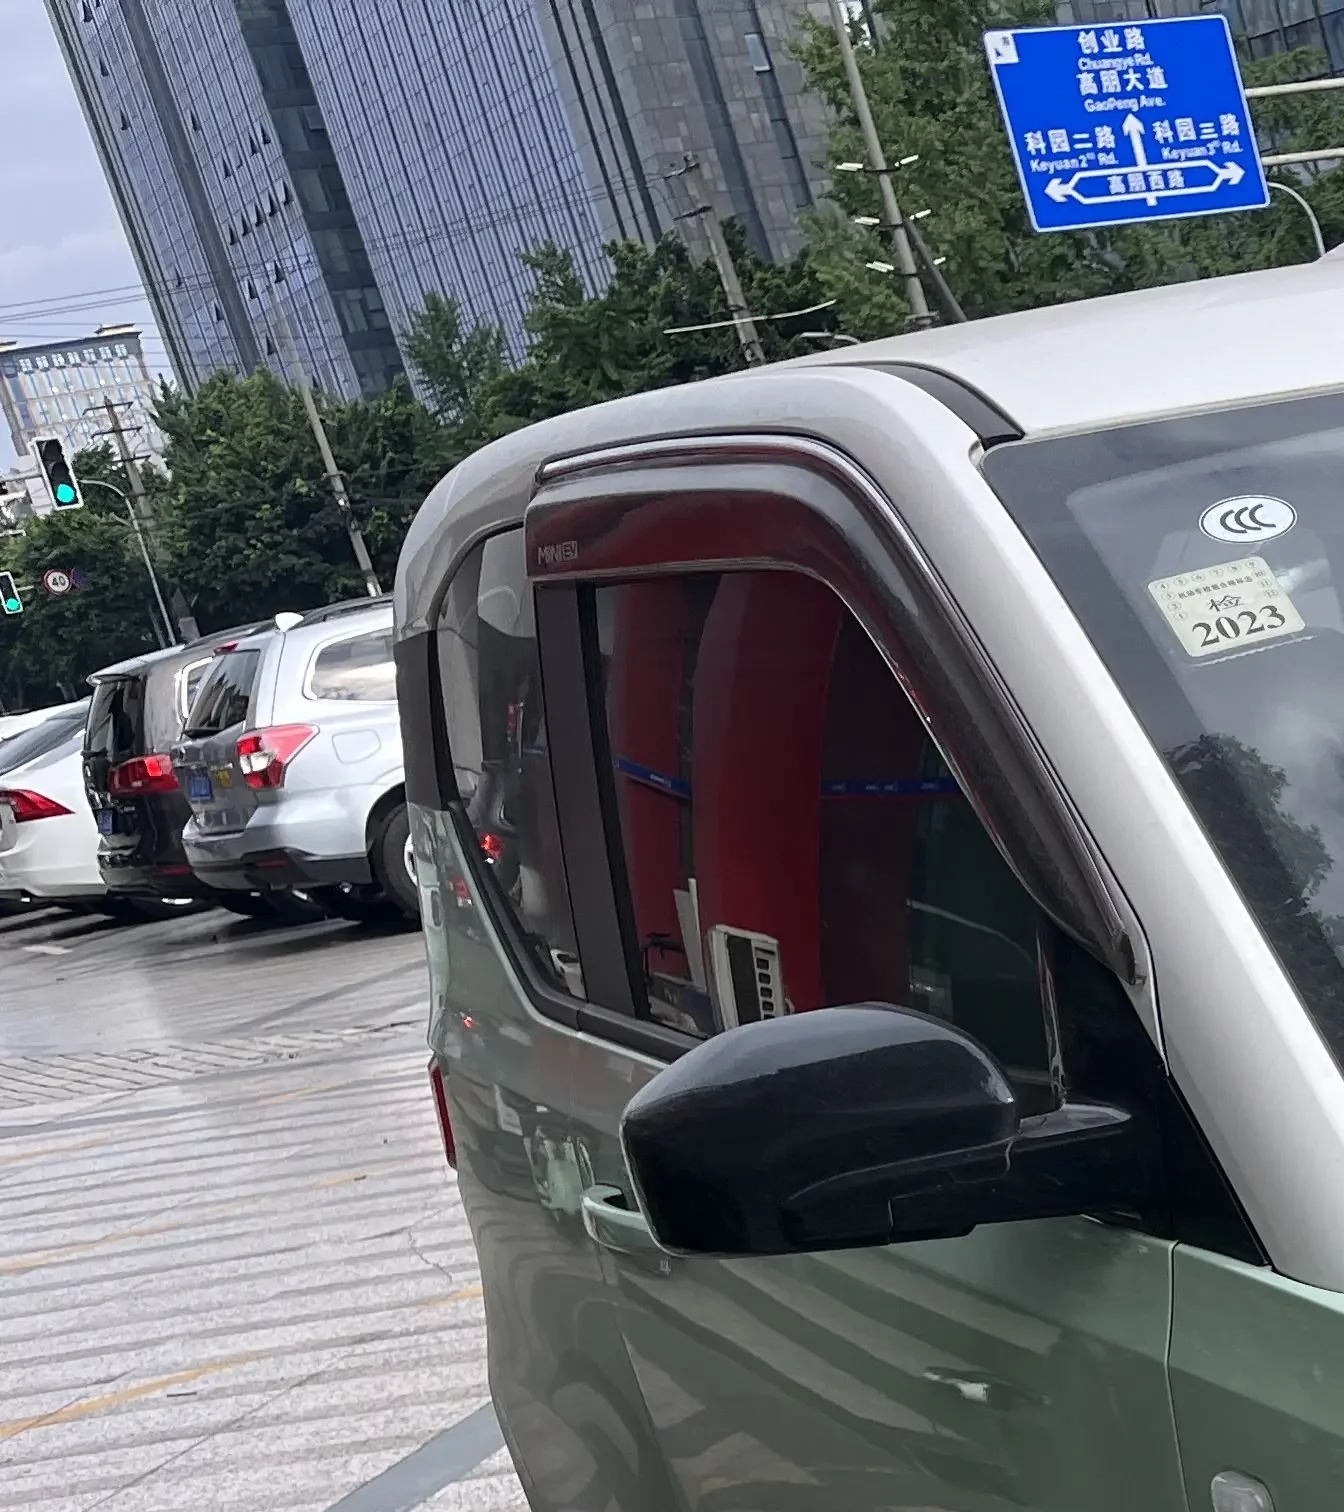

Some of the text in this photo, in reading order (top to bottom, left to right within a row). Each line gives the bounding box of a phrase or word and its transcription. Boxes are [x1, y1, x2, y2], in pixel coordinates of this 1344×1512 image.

[1078, 27, 1145, 54] 创业路
[1076, 66, 1168, 96] 高朋大道
[1140, 95, 1166, 108] Ave.
[1024, 125, 1116, 155] 科园二路
[1152, 113, 1239, 144] 科园三路
[1107, 169, 1185, 195] 高朋西路
[1191, 605, 1286, 648] 2023
